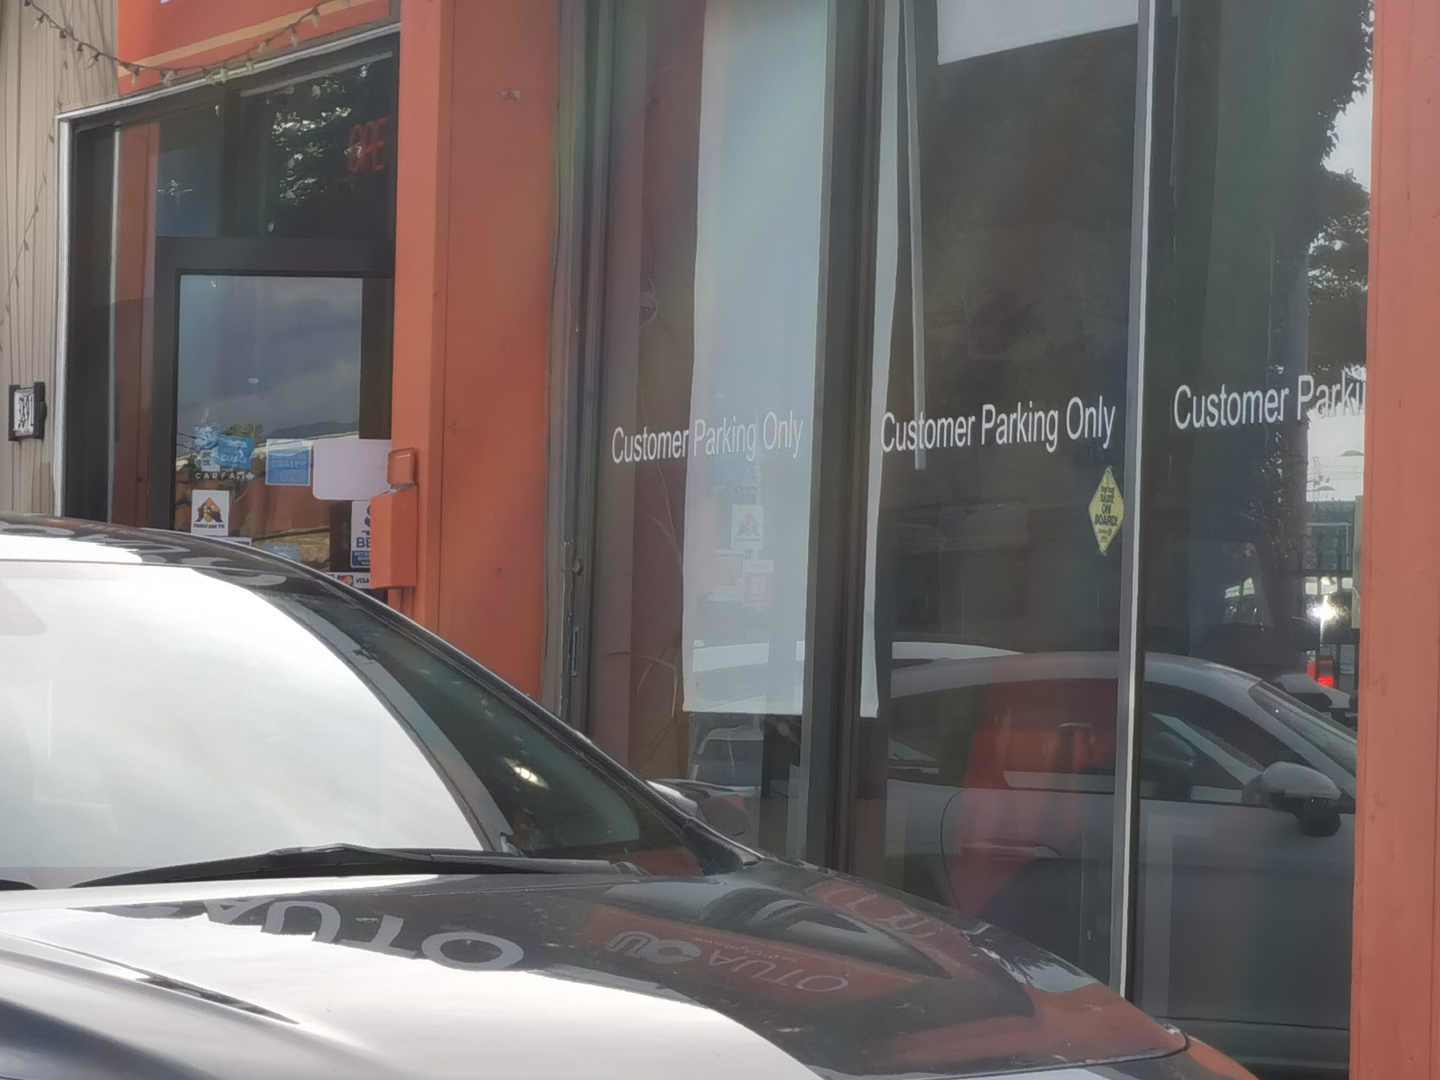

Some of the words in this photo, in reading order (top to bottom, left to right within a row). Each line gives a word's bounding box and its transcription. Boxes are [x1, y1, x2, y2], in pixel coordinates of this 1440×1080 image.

[881, 411, 975, 452] Customer
[981, 401, 1058, 452] Parking
[1066, 395, 1116, 449] Only
[1174, 384, 1289, 430] Customer
[612, 426, 689, 463] Customer
[693, 415, 756, 462] Parking
[763, 410, 804, 458] Only
